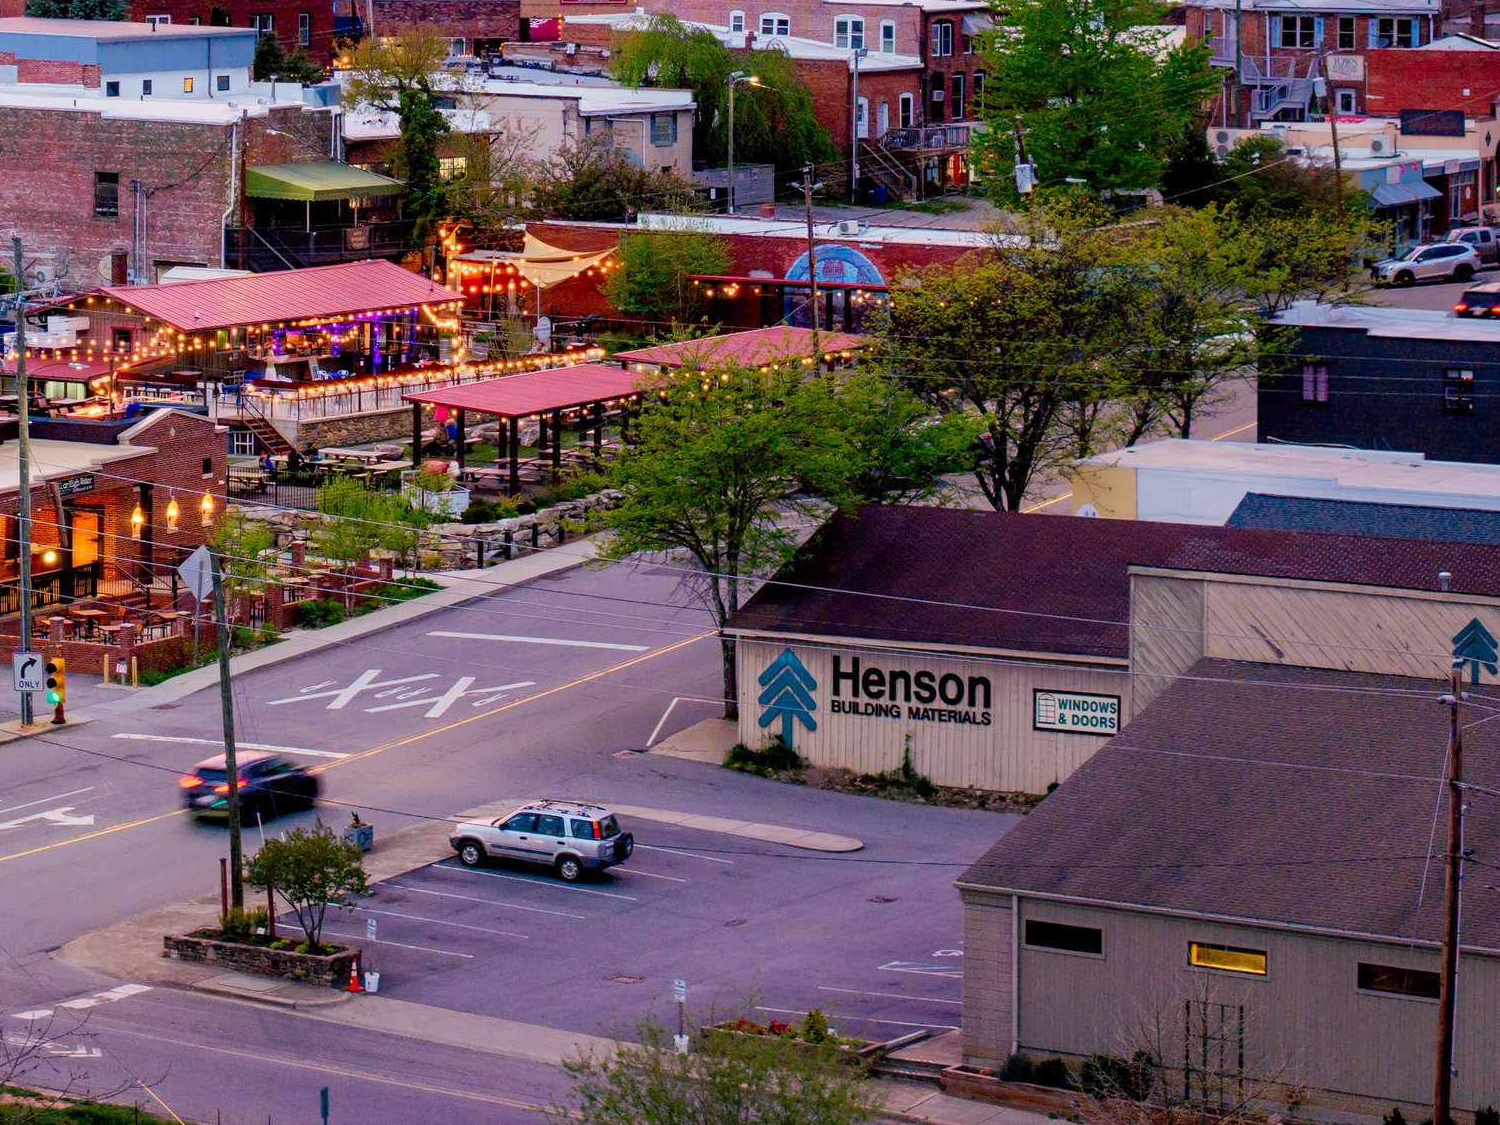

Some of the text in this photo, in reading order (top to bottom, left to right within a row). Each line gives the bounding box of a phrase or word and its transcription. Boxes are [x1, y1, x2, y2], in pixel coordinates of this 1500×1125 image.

[18, 680, 40, 688] ONLY
[831, 655, 992, 709] Henson
[831, 699, 992, 726] BUILDING MATERIALS
[1057, 698, 1117, 714] WINDOWS
[1058, 714, 1116, 729] & DOORS
